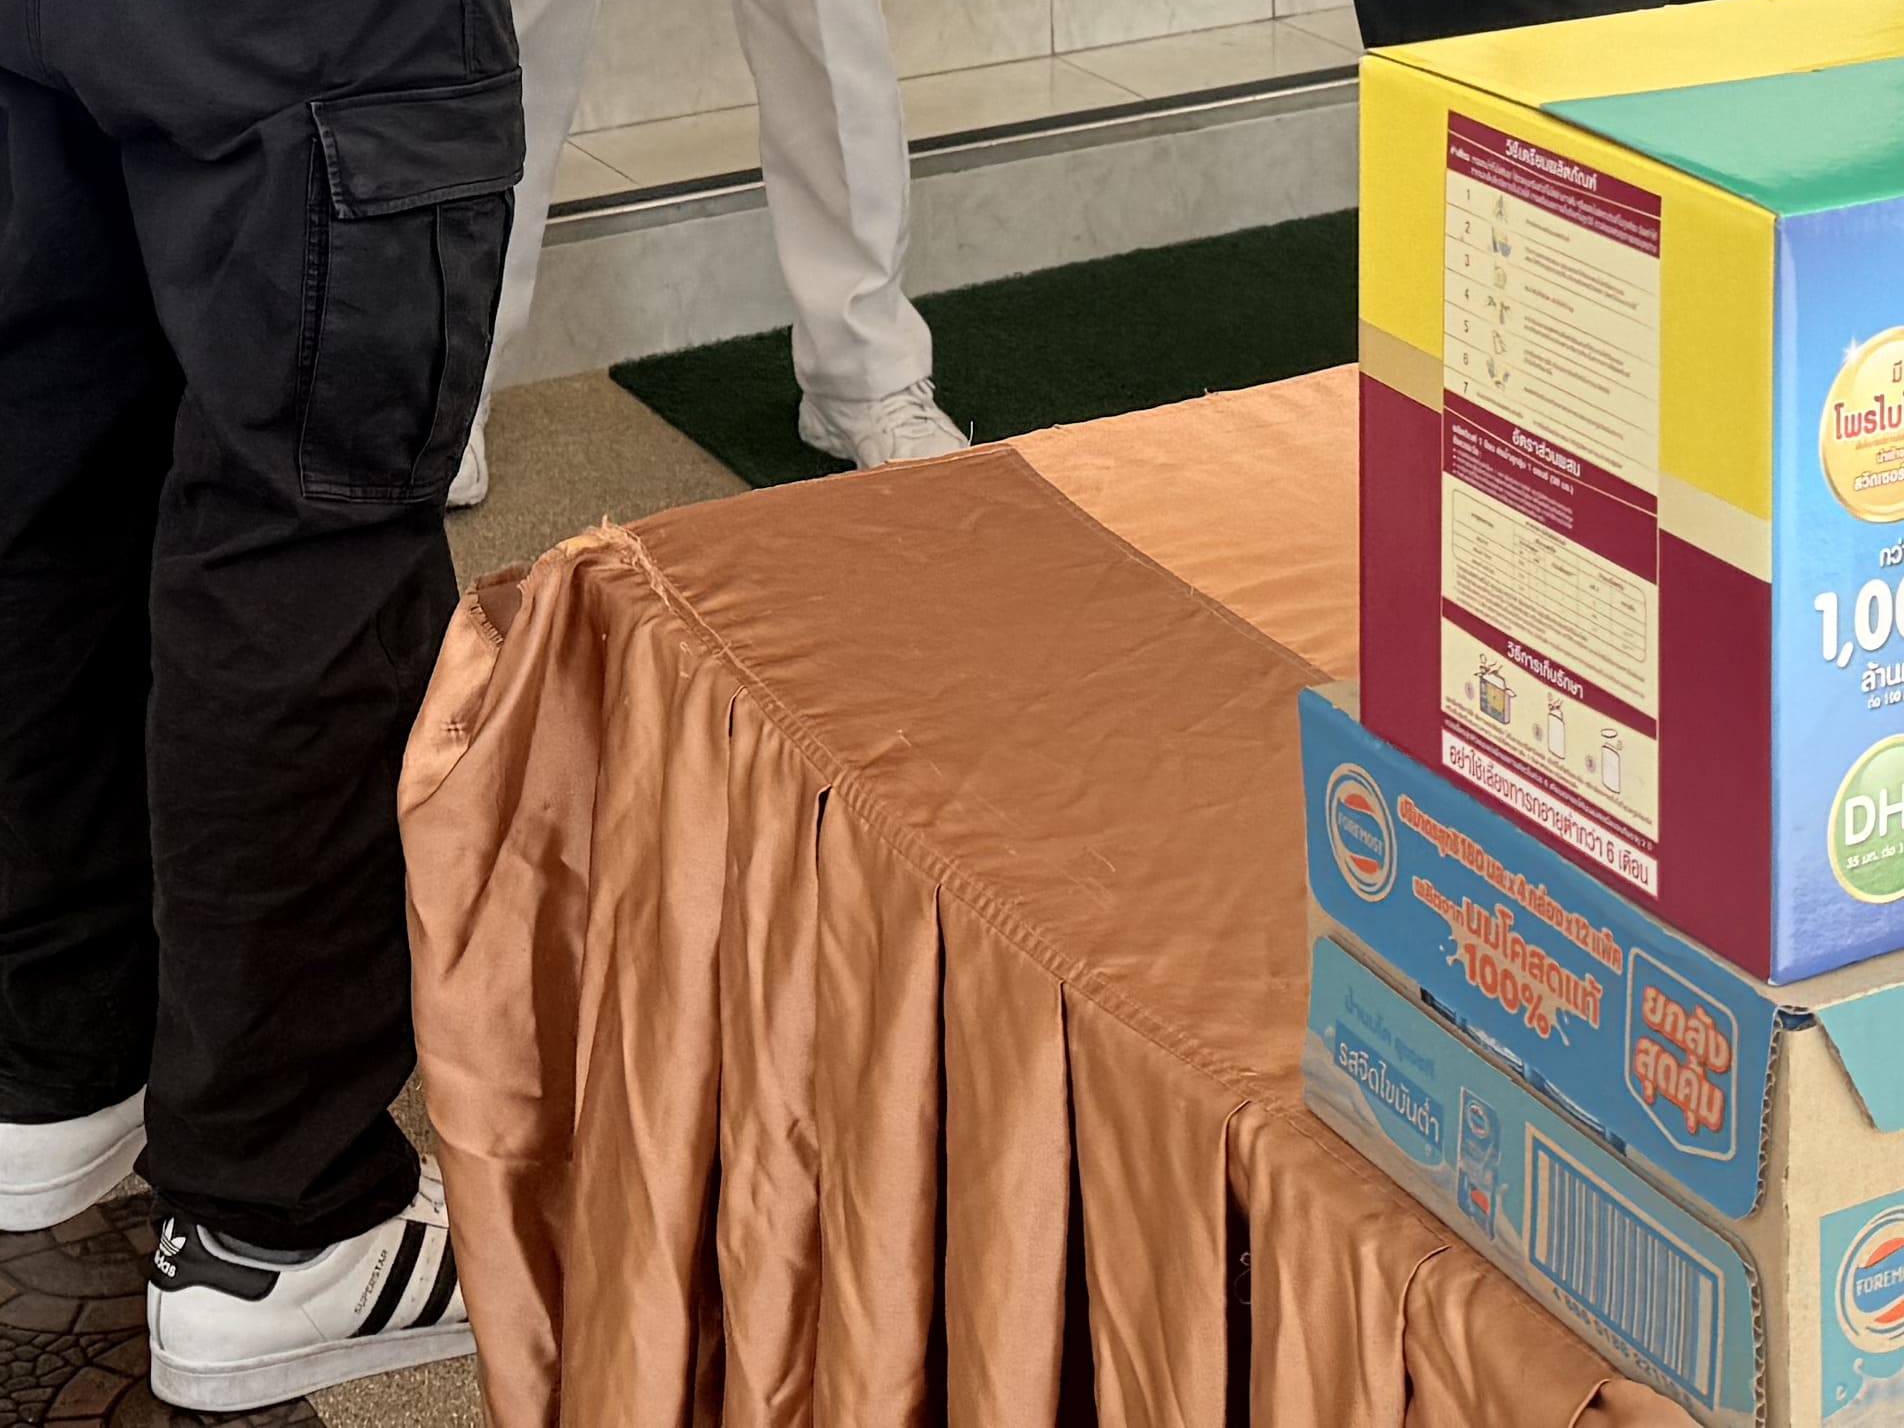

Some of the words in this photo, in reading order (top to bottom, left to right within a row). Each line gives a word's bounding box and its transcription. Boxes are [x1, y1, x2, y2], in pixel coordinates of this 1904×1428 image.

[1892, 359, 1903, 383] มี
[1506, 641, 1584, 699] วิธีการเก็บรักษา
[1449, 744, 1604, 857] อย่าใช้เลี้ยงทารกอายุต่ำกว่า
[1606, 840, 1615, 857] 6
[1618, 848, 1649, 886] เดือน
[1458, 836, 1485, 875] 180
[1514, 878, 1527, 907] 4
[1574, 916, 1590, 948] 12
[1462, 943, 1555, 1039] 100%
[1463, 898, 1603, 1028] นมโคสดแท้
[1642, 985, 1732, 1073] ยกลัง
[1337, 1040, 1441, 1145] รสจืดไขมันต่ำ
[1634, 1037, 1729, 1135] สุดคุ้ม
[354, 1249, 390, 1315] SUPERSTAR
